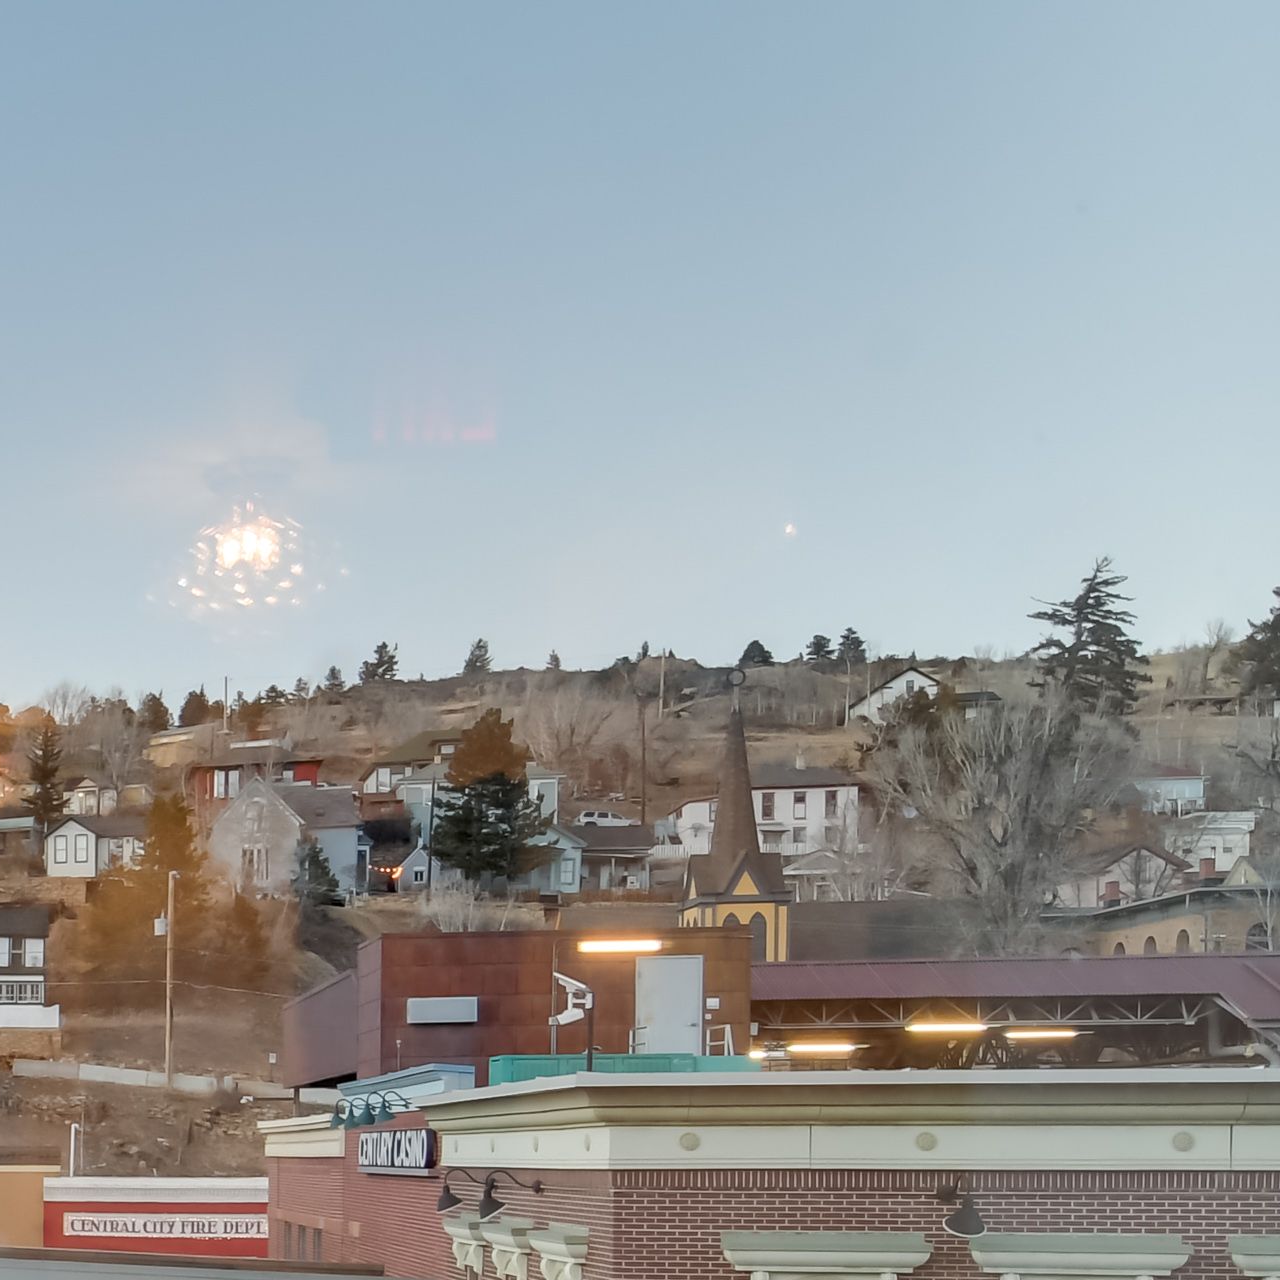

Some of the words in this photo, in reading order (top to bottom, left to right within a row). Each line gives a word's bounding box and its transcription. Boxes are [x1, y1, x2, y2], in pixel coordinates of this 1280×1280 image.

[359, 1131, 394, 1166] CENTURY
[393, 1130, 427, 1167] CASINO
[70, 1218, 140, 1234] CENTRAL
[143, 1219, 176, 1234] CITY
[180, 1220, 217, 1235] FIRE
